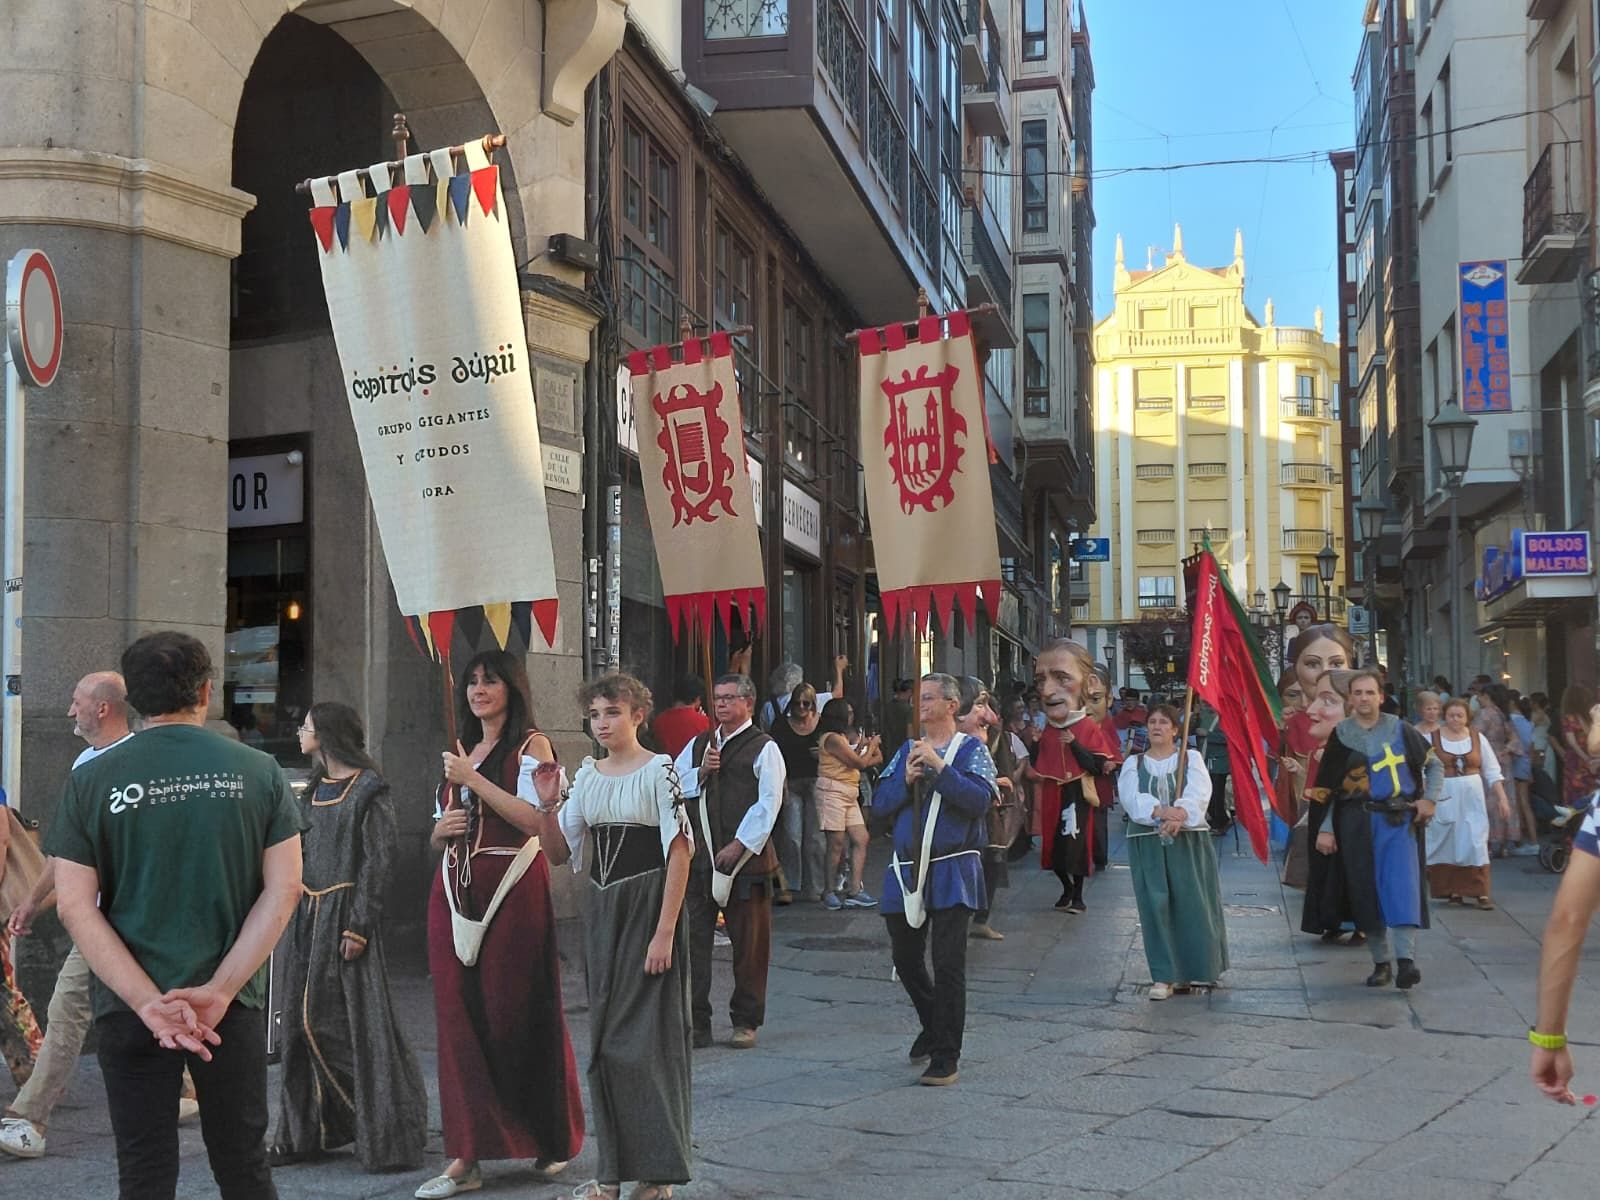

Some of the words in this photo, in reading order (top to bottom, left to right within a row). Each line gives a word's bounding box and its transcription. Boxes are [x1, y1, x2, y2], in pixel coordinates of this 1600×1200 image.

[1464, 303, 1485, 408] MALETAS
[1486, 302, 1508, 409] BOLSOS
[377, 421, 412, 436] GRUPO
[418, 408, 490, 428] GIGANTES
[397, 454, 404, 465] Y
[550, 452, 569, 464] CALLE
[547, 461, 556, 472] DE
[560, 464, 568, 474] LA
[422, 485, 454, 499] ORA
[1528, 538, 1583, 553] BOLSOS
[1526, 557, 1586, 571] MALETAS
[149, 772, 243, 785] ANIVERSARIO
[109, 783, 144, 814] 20
[150, 794, 186, 805] 2005
